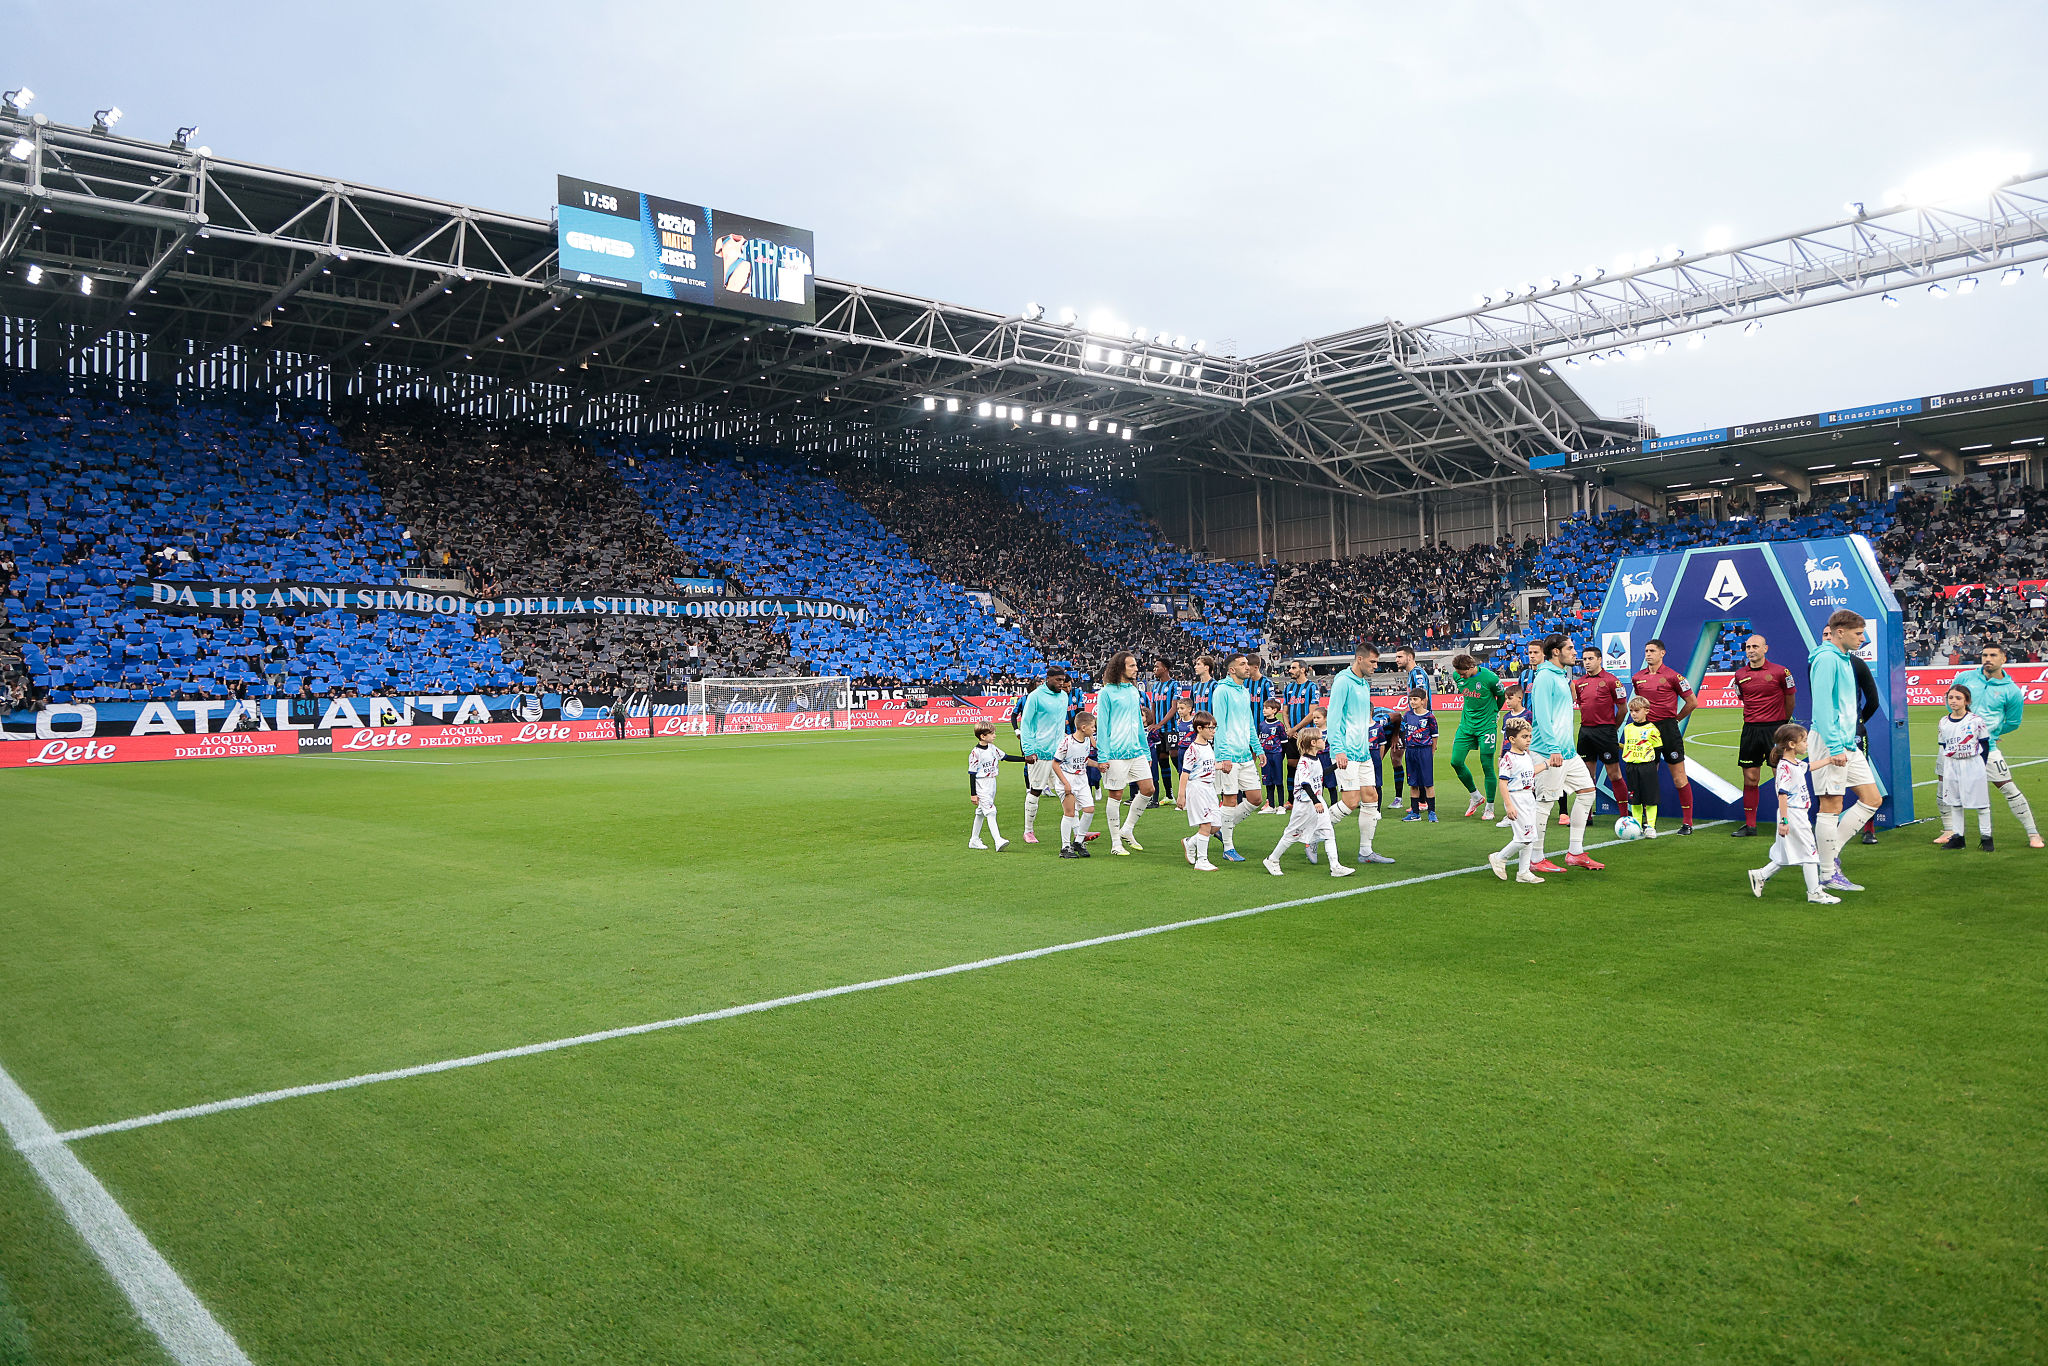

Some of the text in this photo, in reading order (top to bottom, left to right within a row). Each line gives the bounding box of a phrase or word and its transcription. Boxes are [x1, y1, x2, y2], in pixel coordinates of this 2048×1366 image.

[661, 231, 693, 252] MATCH
[688, 278, 707, 288] STORE
[1930, 387, 2024, 409] Rinascimento
[1828, 404, 1913, 423] Rinascimento
[1735, 419, 1813, 438] Rinascimento
[1650, 433, 1720, 450] Rinascimento
[1571, 446, 1636, 462] Rinascimento
[150, 582, 870, 625] DA 118 ANNI SIMBOLO DELLA STIRPE OROBICA, INDOM
[1809, 595, 1848, 606] enilive
[1626, 608, 1658, 617] enilive
[1906, 688, 1931, 696] QUA
[1912, 696, 1945, 704] SPOR
[130, 694, 493, 737] ATALANTA
[731, 715, 764, 724] ACQUA
[785, 713, 831, 729] Lete
[850, 712, 879, 720] ACQUA
[898, 710, 939, 726] Lete
[943, 715, 993, 724] DELLO SPORT
[595, 721, 633, 730] ACA
[658, 716, 709, 735] Lete
[723, 724, 746, 732] ELLO
[866, 719, 892, 727] SPORT
[440, 726, 483, 736] ACQUA
[511, 723, 571, 742] Lete
[578, 728, 650, 739] DELLO PORT
[200, 734, 253, 746] ACQUA
[298, 736, 332, 746] 00:00
[342, 729, 412, 750] Lete
[419, 735, 503, 747] DELLO SPORT
[1167, 734, 1178, 743] 69
[1484, 733, 1496, 744] 29
[26, 740, 117, 764] Lete
[174, 743, 277, 757] DELLO SPORT
[1993, 759, 2008, 773] 10
